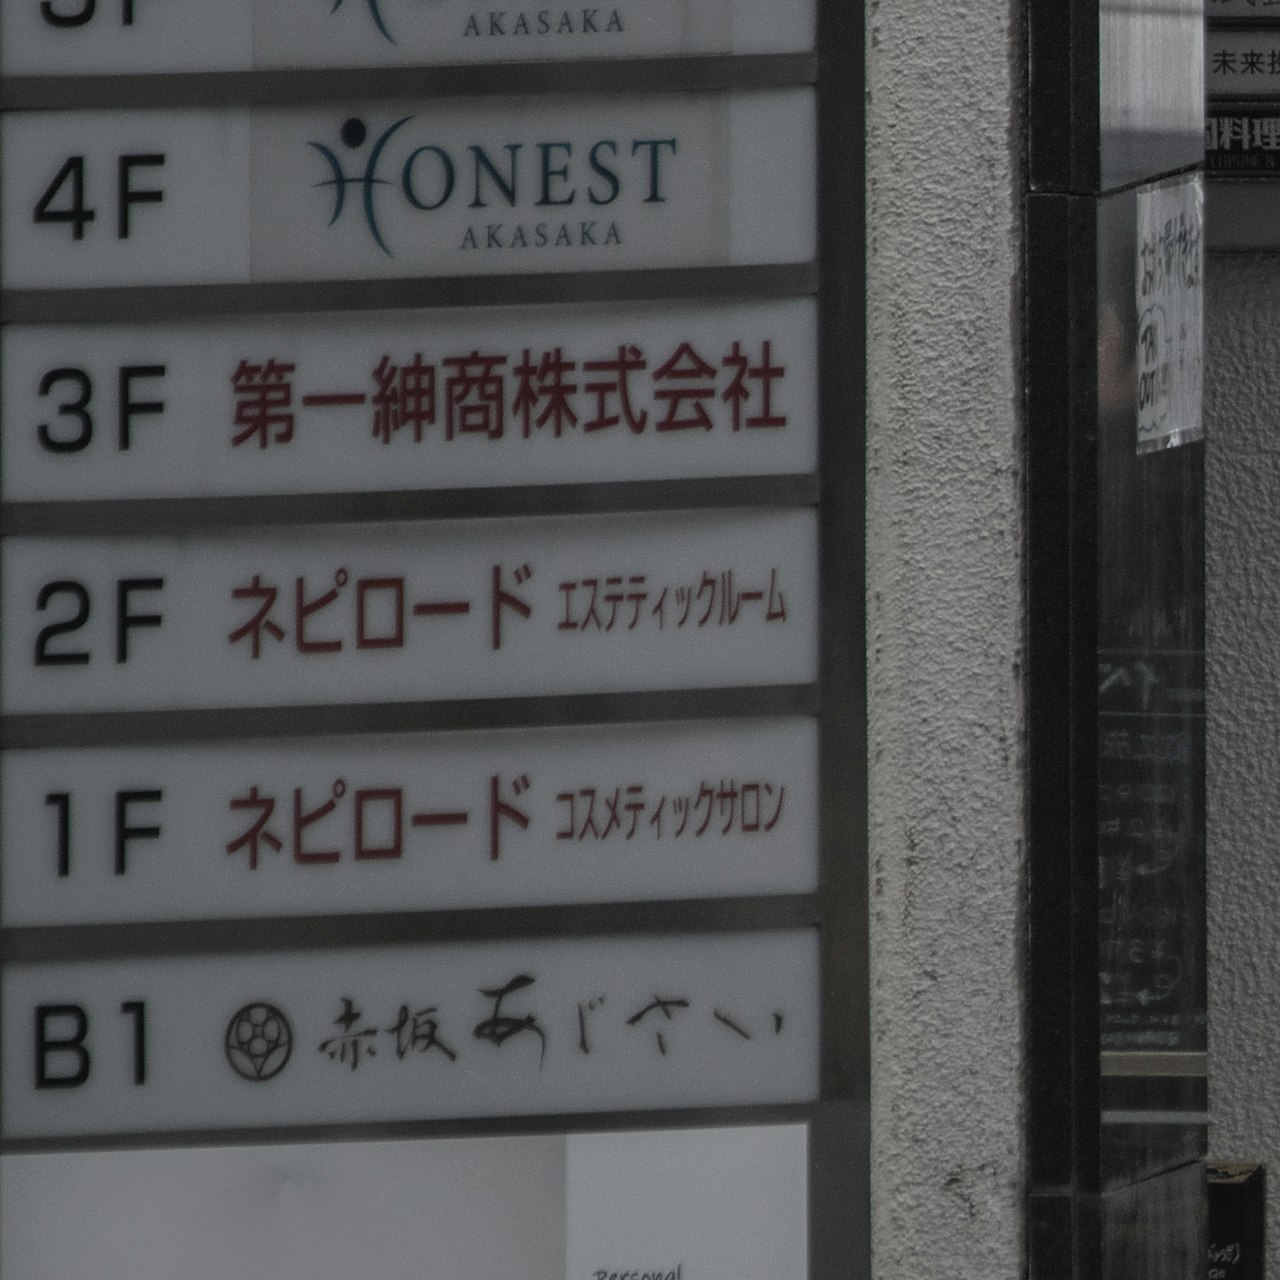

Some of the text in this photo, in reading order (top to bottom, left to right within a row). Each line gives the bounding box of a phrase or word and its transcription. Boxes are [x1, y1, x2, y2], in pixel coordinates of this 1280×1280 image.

[463, 8, 624, 37] AKASAKA
[33, 114, 678, 259] 4F HONEST
[460, 221, 623, 250] AKASAKA
[36, 340, 788, 455] 3F 第一紳商株式会社
[33, 563, 788, 668] 2F ネピロード エステティックルーム
[44, 773, 785, 878] 1F ネピロード コスメティックサロン
[34, 999, 148, 1091] B1
